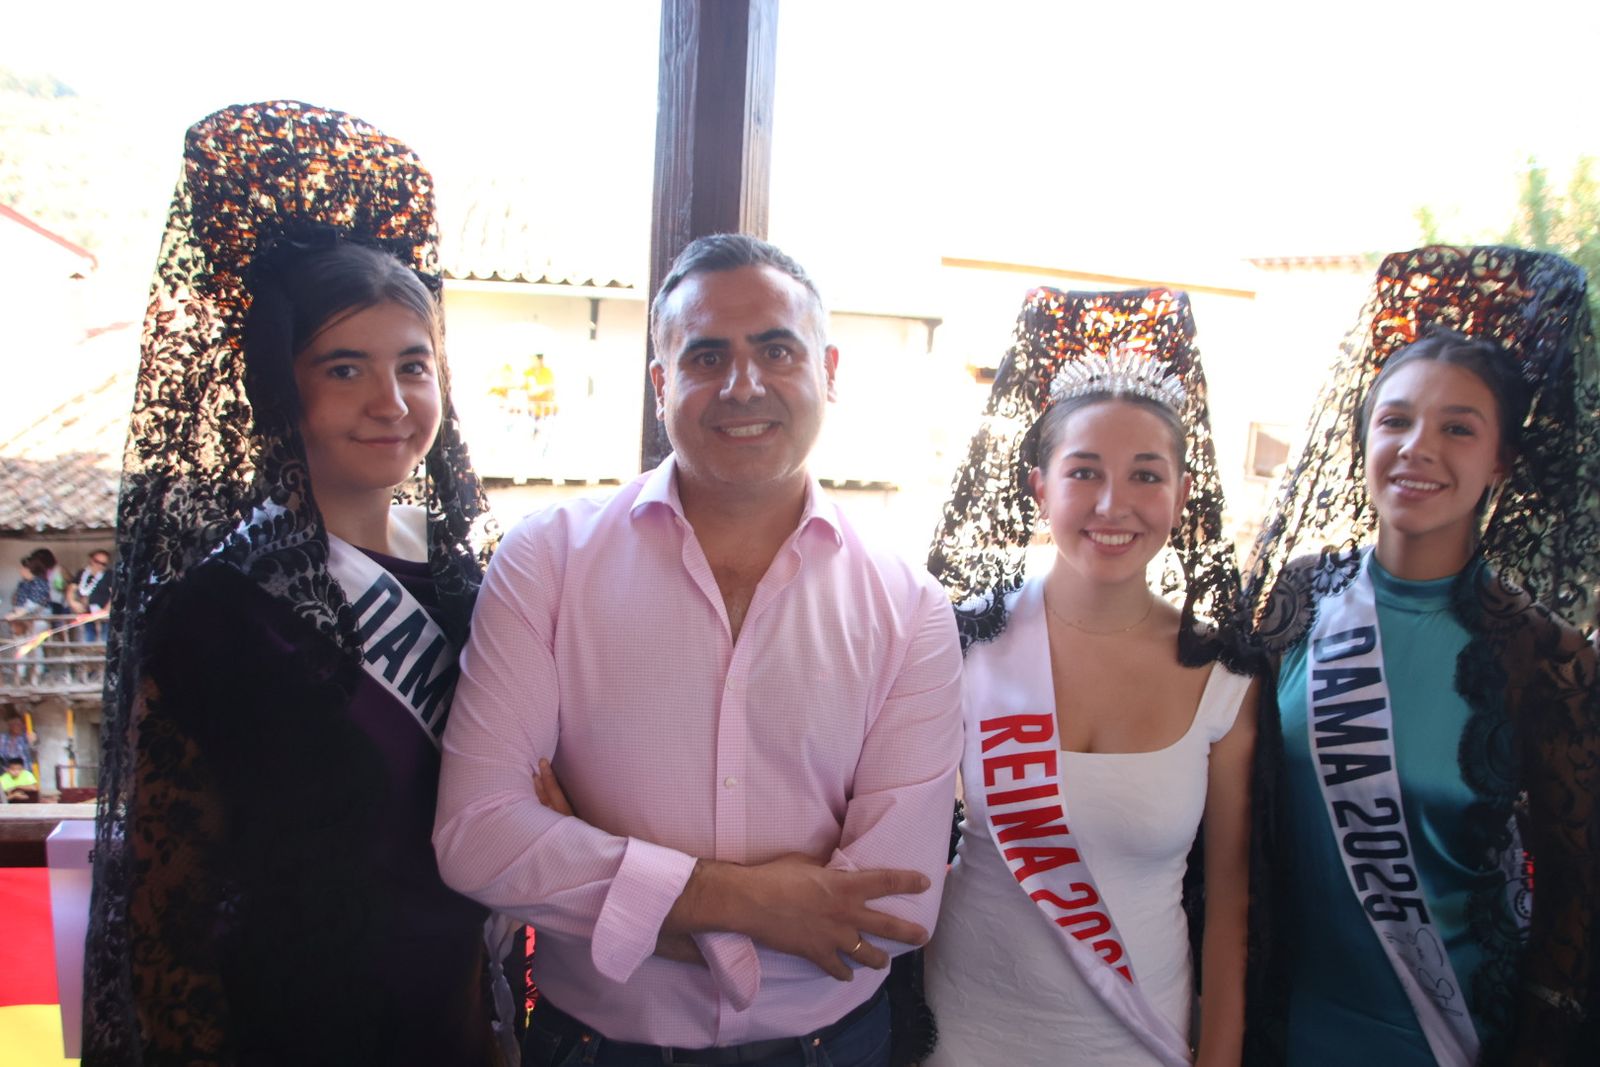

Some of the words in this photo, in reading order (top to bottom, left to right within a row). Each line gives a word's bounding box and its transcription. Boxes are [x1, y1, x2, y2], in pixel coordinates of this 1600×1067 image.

[351, 572, 456, 738] DAM
[1313, 625, 1392, 787] DAMA
[980, 713, 1080, 884] REINA
[1332, 798, 1430, 924] 2025
[1029, 882, 1133, 984] 20
